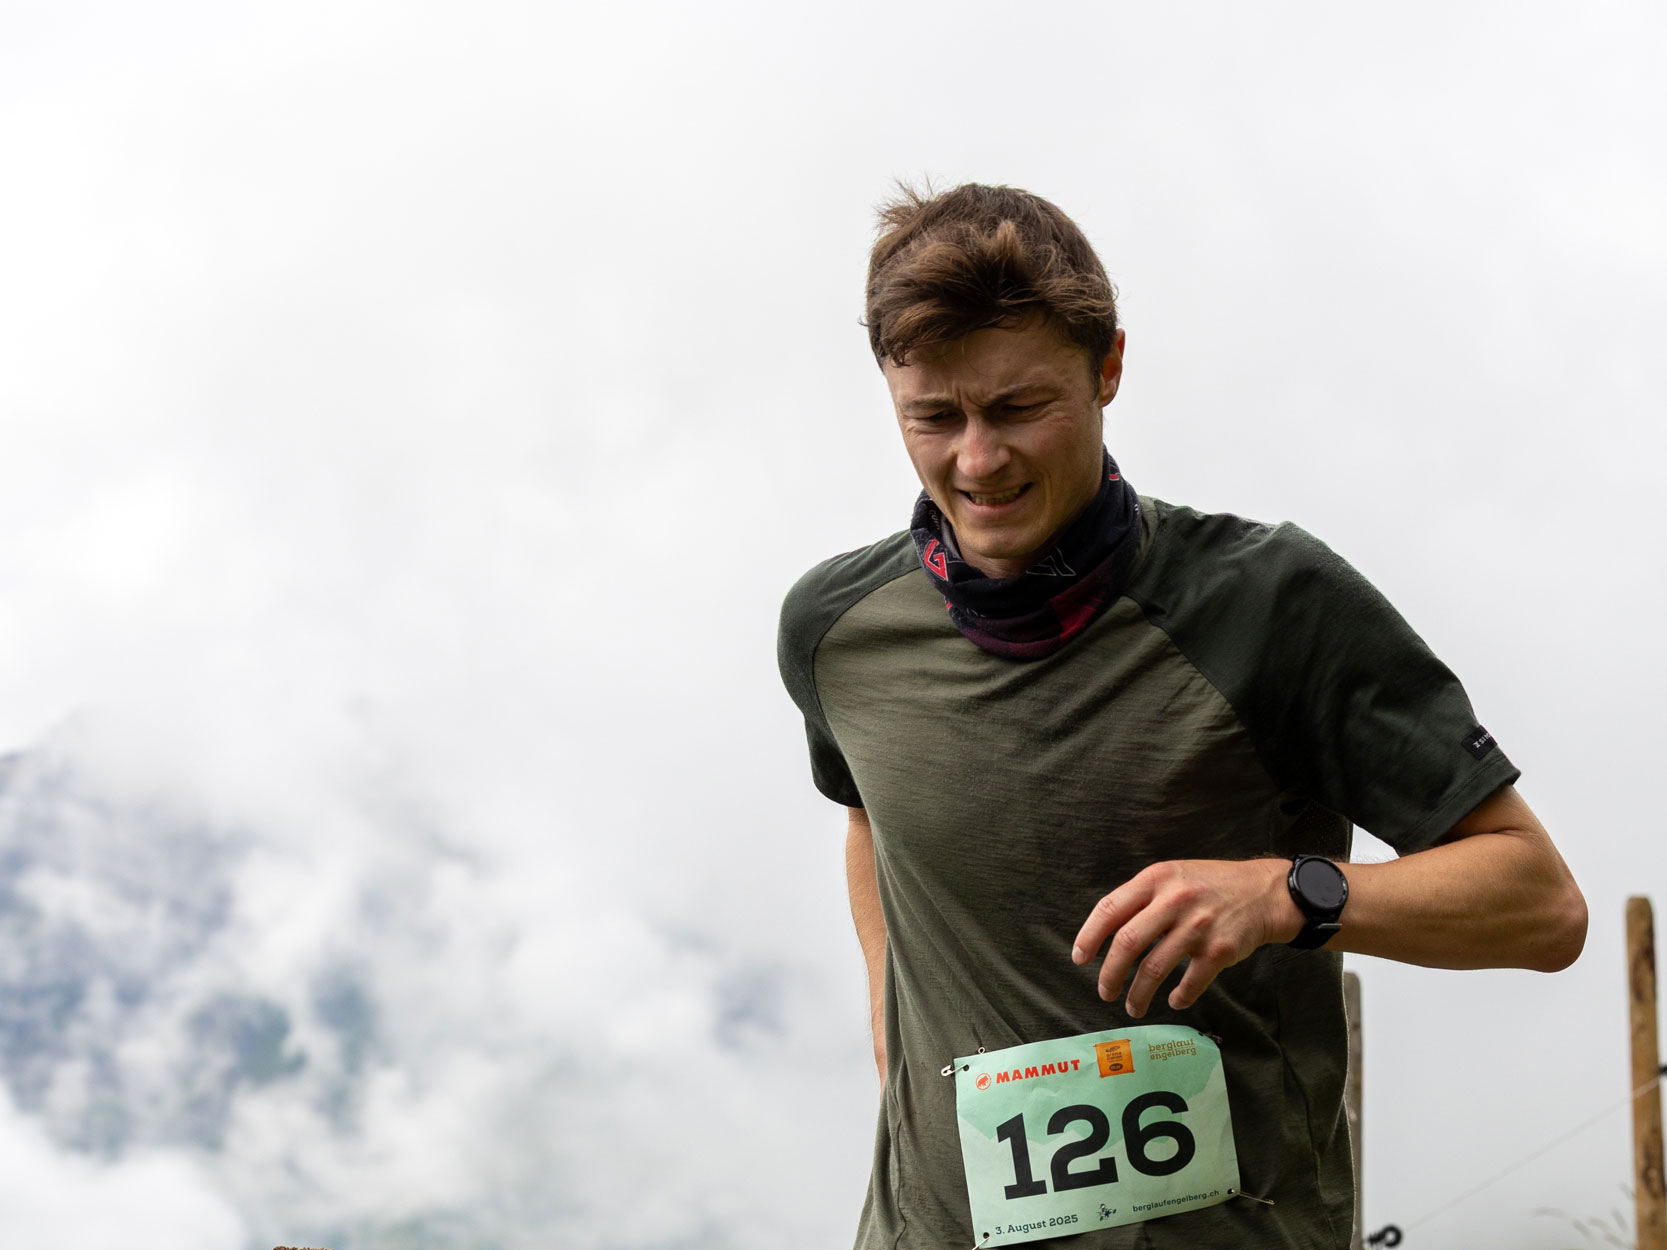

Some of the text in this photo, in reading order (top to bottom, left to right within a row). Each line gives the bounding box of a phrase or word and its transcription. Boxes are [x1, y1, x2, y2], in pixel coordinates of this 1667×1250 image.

[1148, 1038, 1194, 1051] berglauf
[1150, 1047, 1197, 1061] engelberg
[996, 1059, 1080, 1085] MAMMUT
[996, 1090, 1196, 1200] 126
[1132, 1189, 1219, 1212] berglaufengelberg.ch
[995, 1214, 1079, 1235] 3. August 2025
